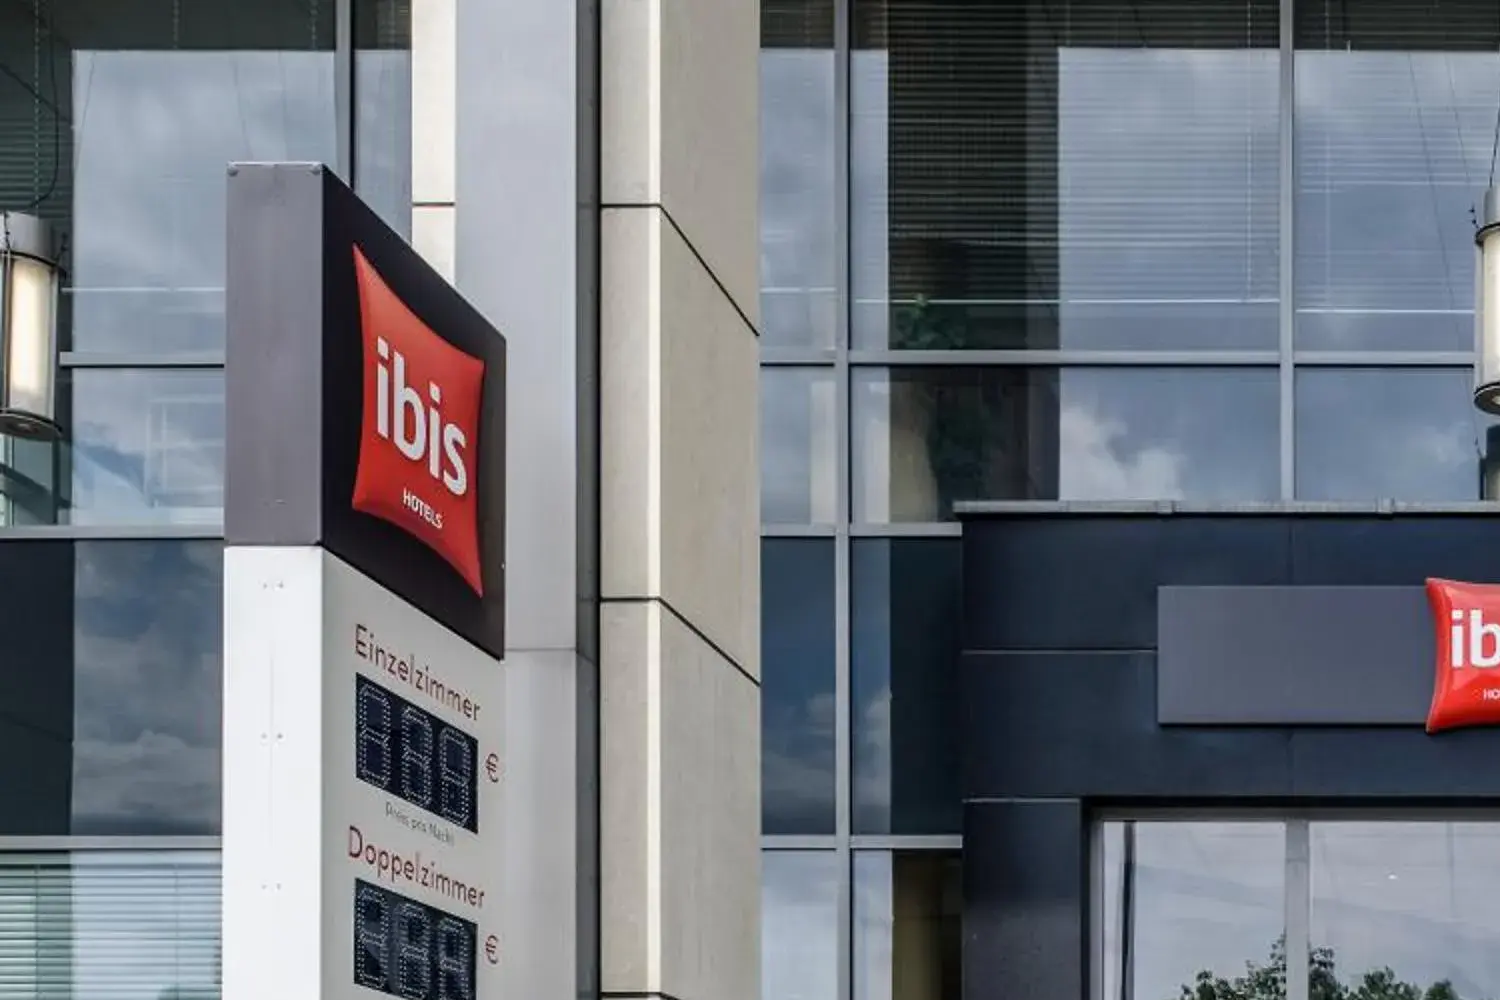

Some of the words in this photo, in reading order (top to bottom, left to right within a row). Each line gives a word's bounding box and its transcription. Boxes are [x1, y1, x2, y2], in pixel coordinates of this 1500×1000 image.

[376, 335, 468, 496] ibis
[402, 487, 444, 529] HOTELS
[355, 623, 481, 721] Einzelzimmer
[347, 824, 485, 909] Doppelzimmer
